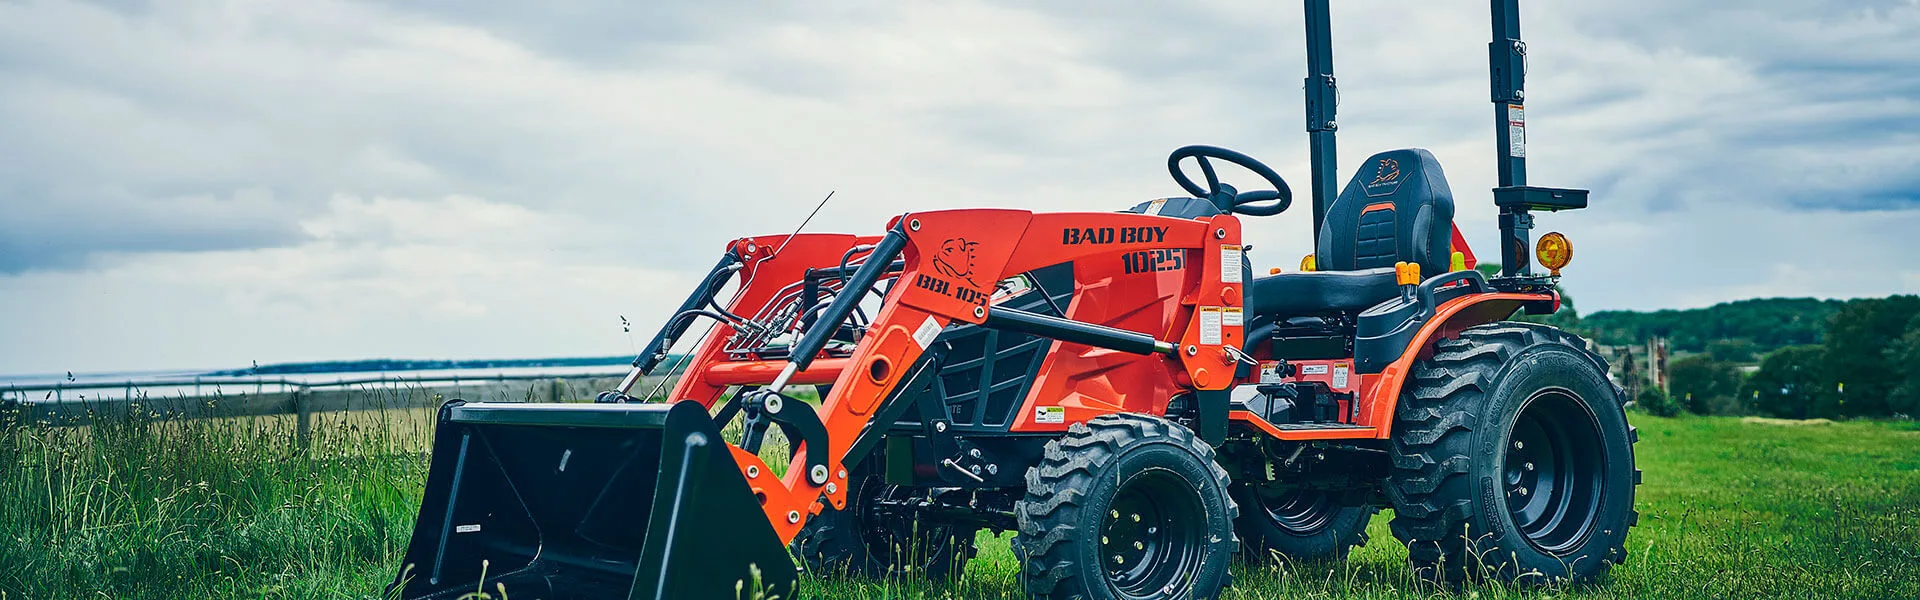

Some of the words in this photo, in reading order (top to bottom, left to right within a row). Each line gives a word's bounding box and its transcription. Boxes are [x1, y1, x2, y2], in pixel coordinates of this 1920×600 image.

[1062, 227, 1115, 245] BAD
[1120, 226, 1170, 244] BOY
[915, 273, 952, 297] BBL
[956, 286, 989, 307] 105
